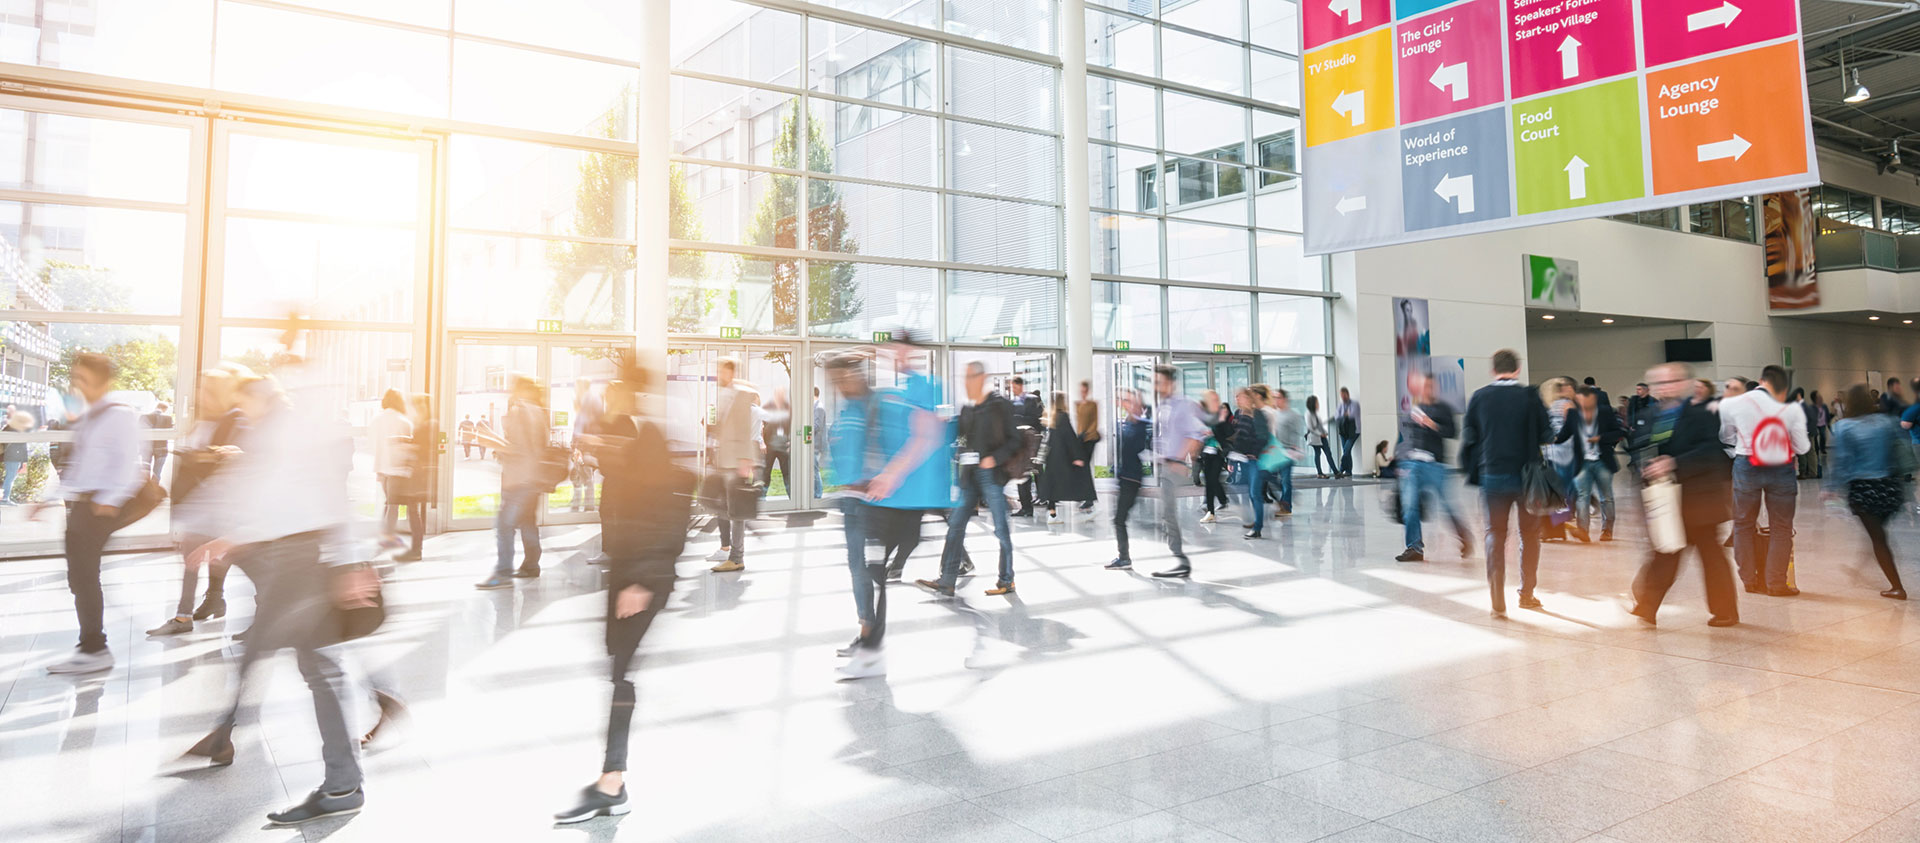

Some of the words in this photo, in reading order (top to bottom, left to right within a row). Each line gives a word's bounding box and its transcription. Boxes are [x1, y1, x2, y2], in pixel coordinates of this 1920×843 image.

[1401, 30, 1421, 44] The
[1423, 17, 1454, 37] Girls'
[1515, 22, 1560, 41] Start-up
[1560, 11, 1598, 28] Village
[1401, 39, 1442, 58] Lounge
[1308, 62, 1322, 76] TV
[1323, 53, 1356, 71] Studio
[1658, 76, 1720, 99] Agency
[1520, 107, 1553, 125] Food
[1660, 98, 1719, 119] Lounge
[1404, 130, 1440, 150] World
[1443, 128, 1456, 141] of
[1520, 125, 1560, 142] Court
[1405, 145, 1468, 166] Experience
